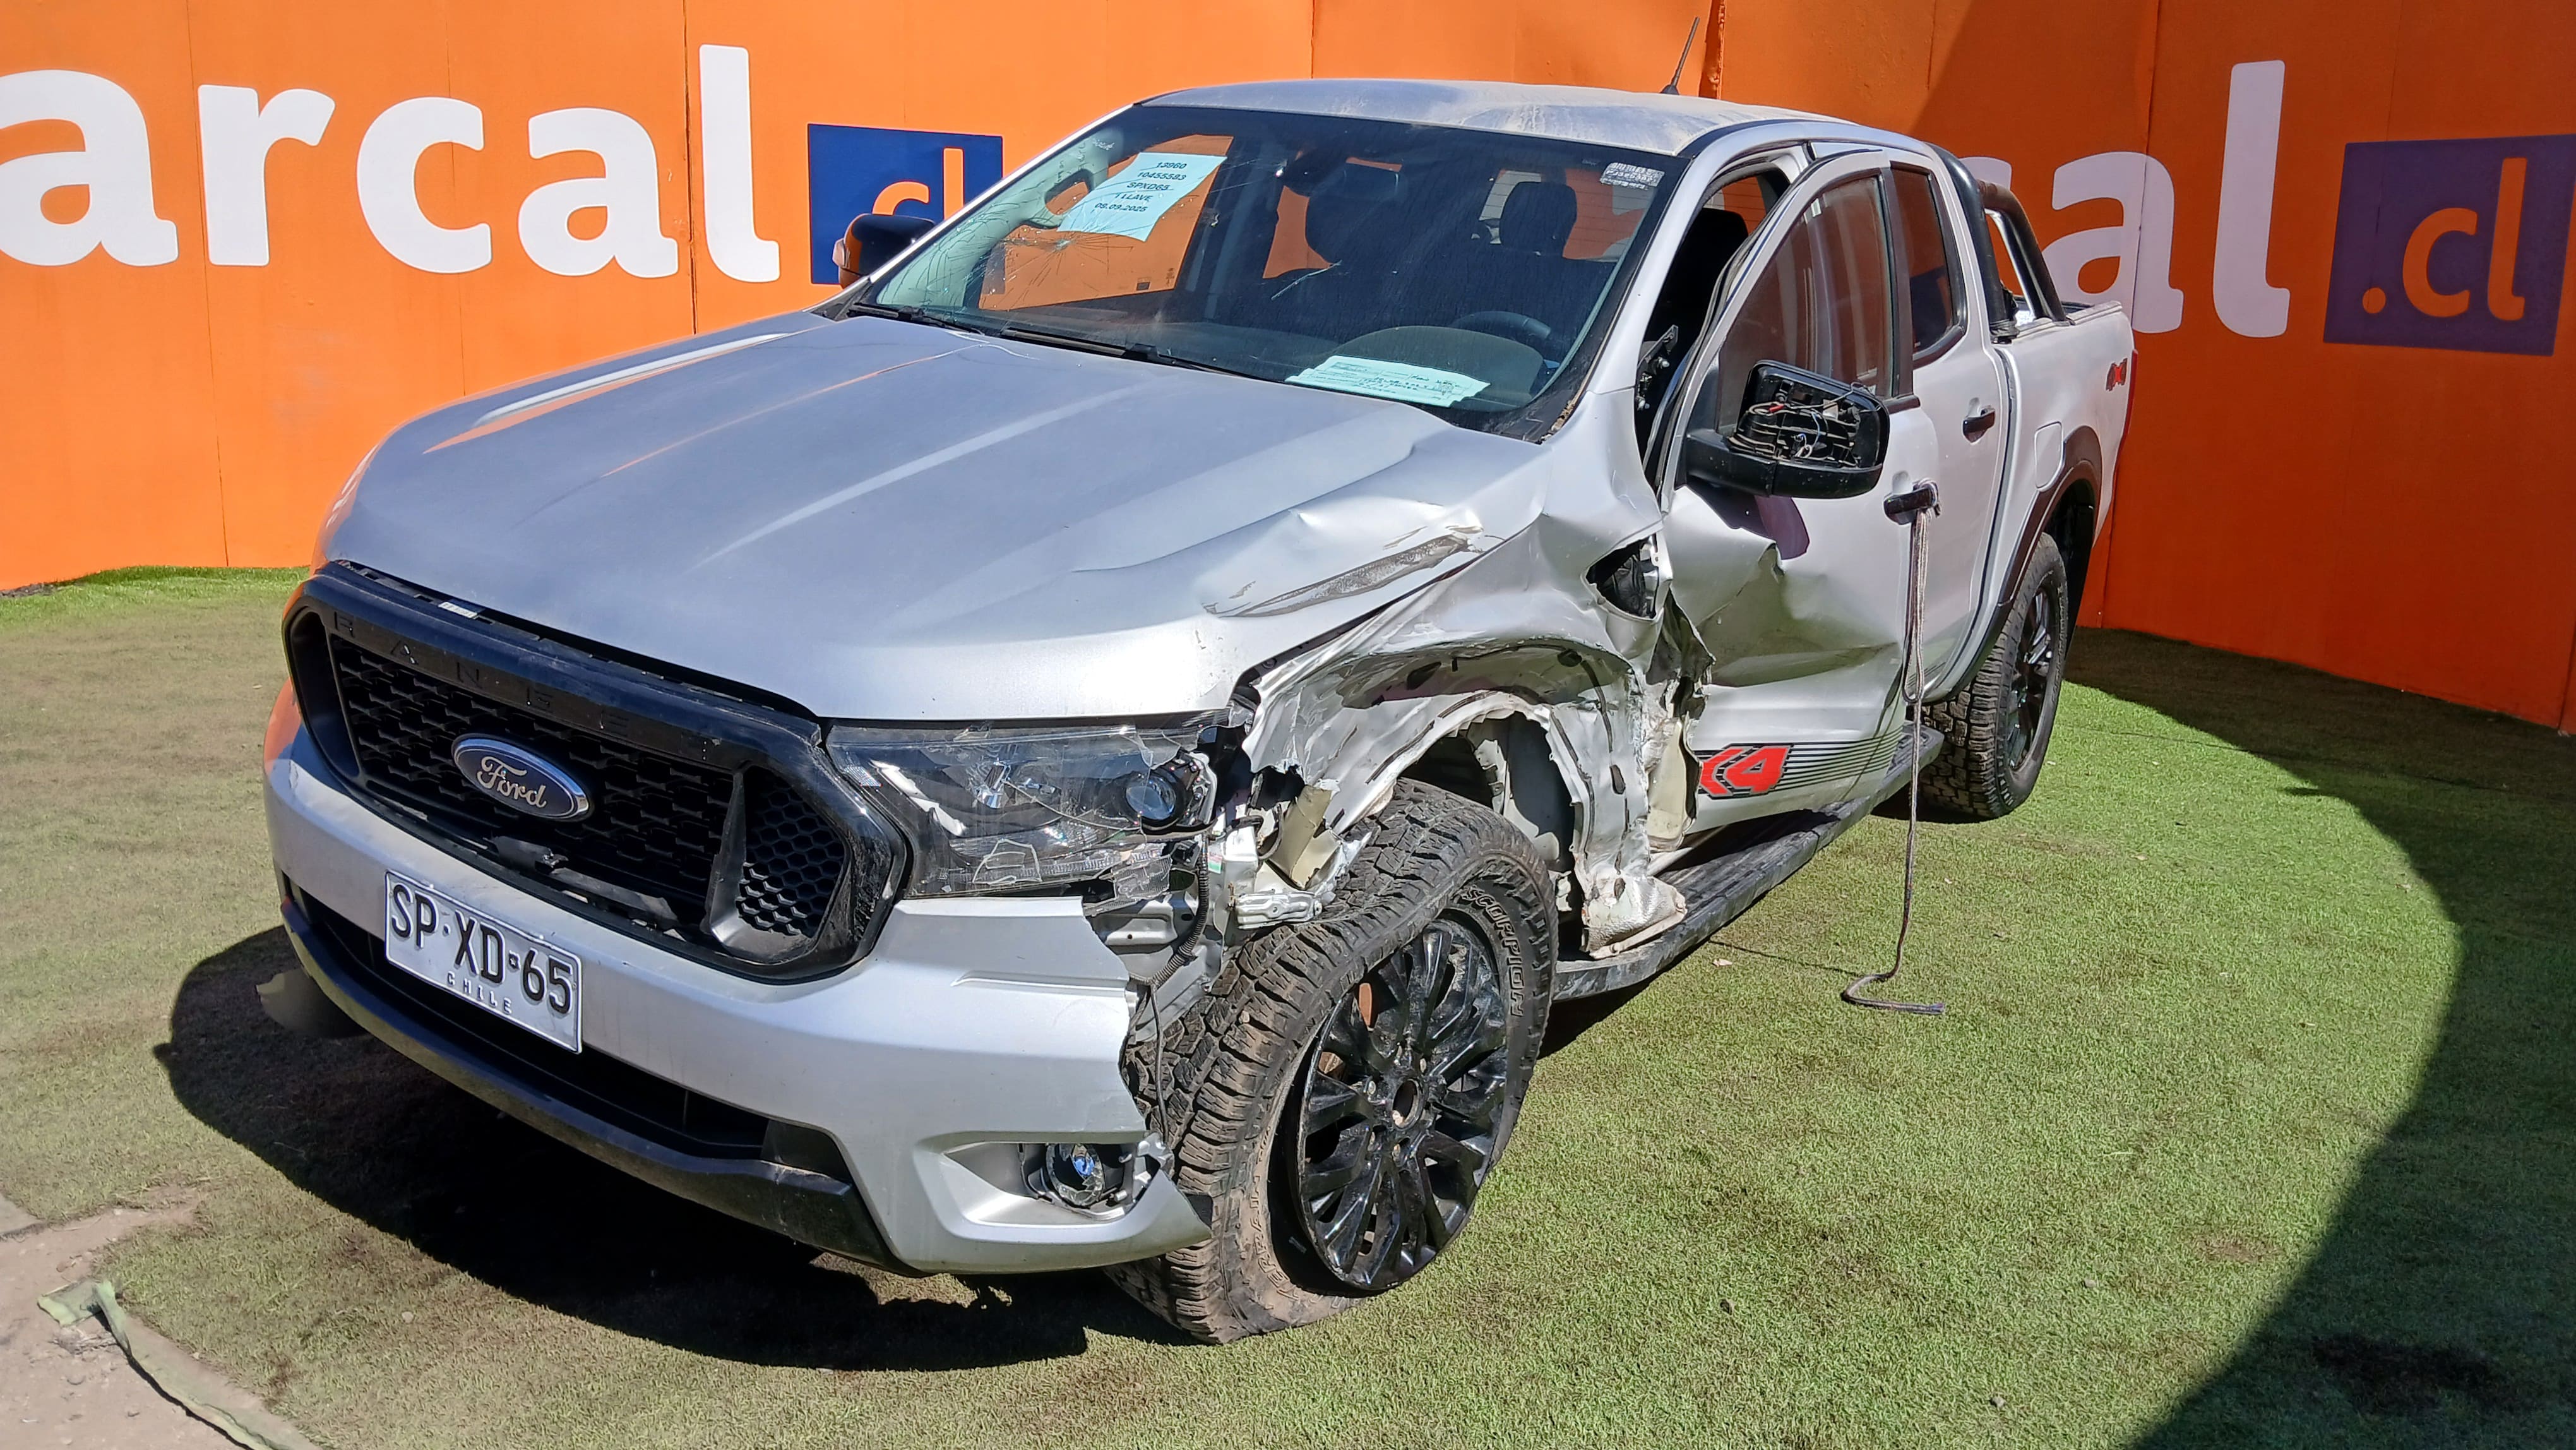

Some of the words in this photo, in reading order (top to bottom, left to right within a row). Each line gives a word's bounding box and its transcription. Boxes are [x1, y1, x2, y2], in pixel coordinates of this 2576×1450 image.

[0, 44, 780, 282] arcal
[1126, 182, 1171, 191] SPXD65
[1957, 59, 2291, 338] al
[2362, 157, 2527, 321] .cl
[477, 756, 547, 808] Ford
[446, 970, 513, 1014] CHILE
[1460, 884, 1525, 1017] SCORPION
